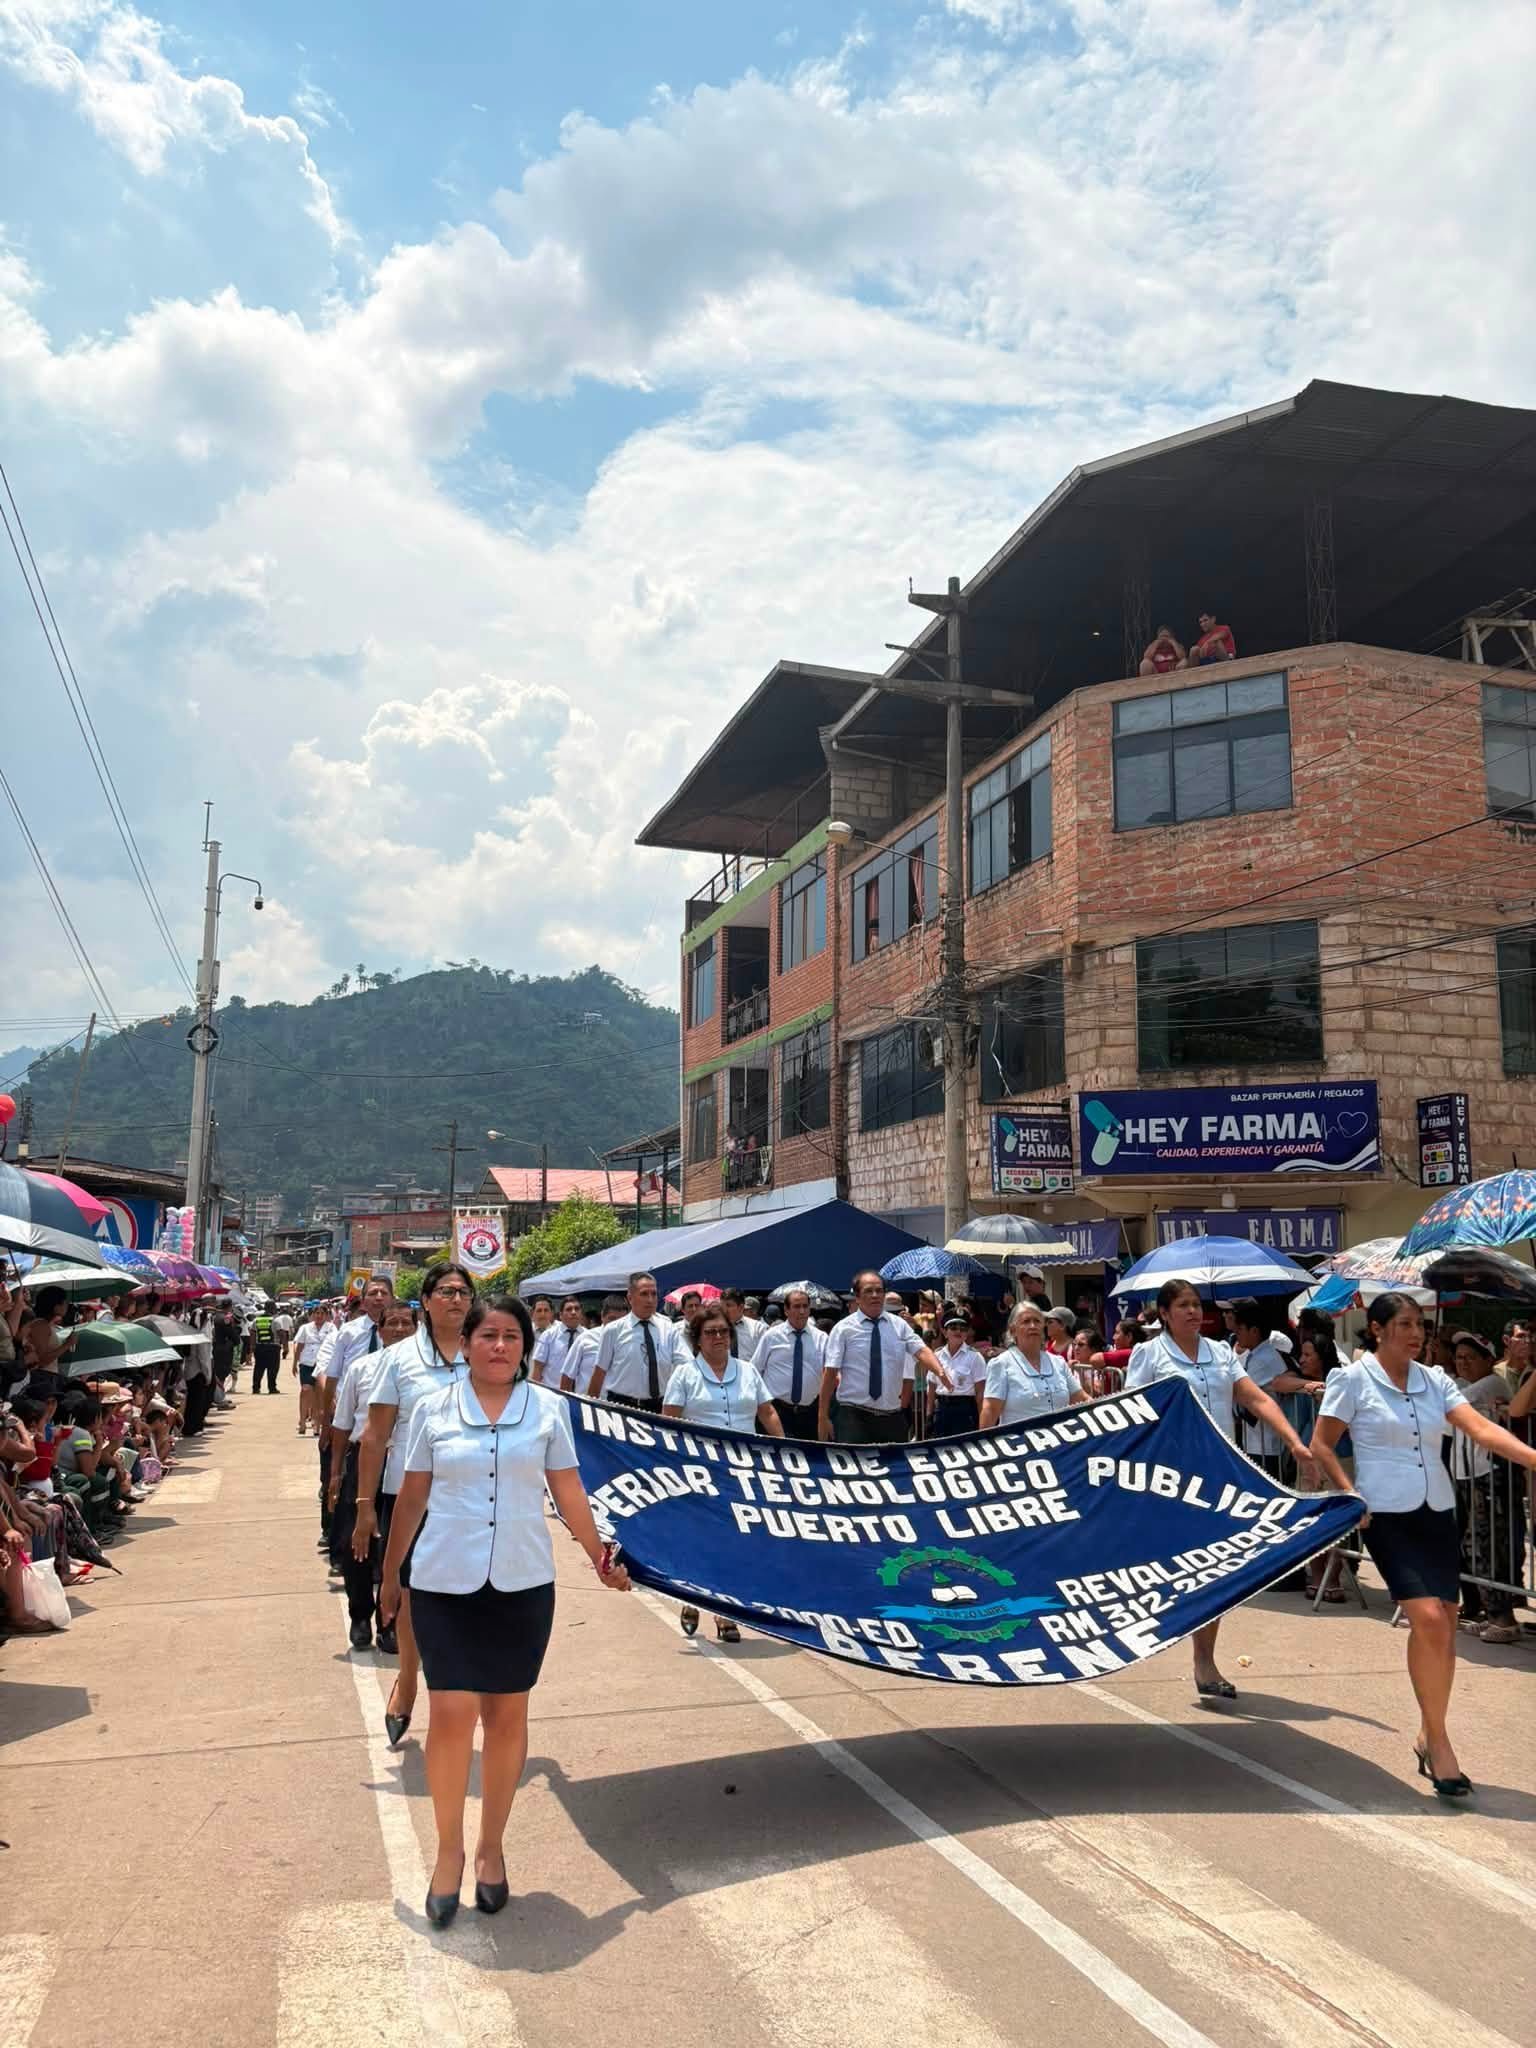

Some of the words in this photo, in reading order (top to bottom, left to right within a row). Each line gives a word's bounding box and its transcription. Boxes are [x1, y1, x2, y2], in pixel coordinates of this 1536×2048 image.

[1324, 1088, 1365, 1098] REGALOS
[1428, 1104, 1441, 1116] HEY
[1428, 1116, 1451, 1129] FARMA
[1455, 1095, 1465, 1127] HEY
[1019, 1127, 1049, 1142] HEY
[1125, 1116, 1189, 1143] HEY
[1201, 1112, 1322, 1142] FARMA
[1018, 1143, 1071, 1158] FARMA
[1201, 1145, 1264, 1157] EXPERIENCIA
[1265, 1145, 1272, 1154] Y
[1273, 1141, 1325, 1156] GARANTÍA
[1457, 1132, 1469, 1184] FARMA
[1247, 1217, 1334, 1248] FARMA
[579, 1402, 811, 1476] INSTITUTO
[825, 1447, 890, 1477] DE
[902, 1393, 1161, 1474] EDUCACION
[728, 1458, 1059, 1507] TECNOLOGICO
[1087, 1456, 1297, 1522] PUBLICO
[730, 1501, 918, 1543] PUERTO
[935, 1488, 1081, 1539] LIBRE
[1056, 1518, 1283, 1607] REVALIDADO
